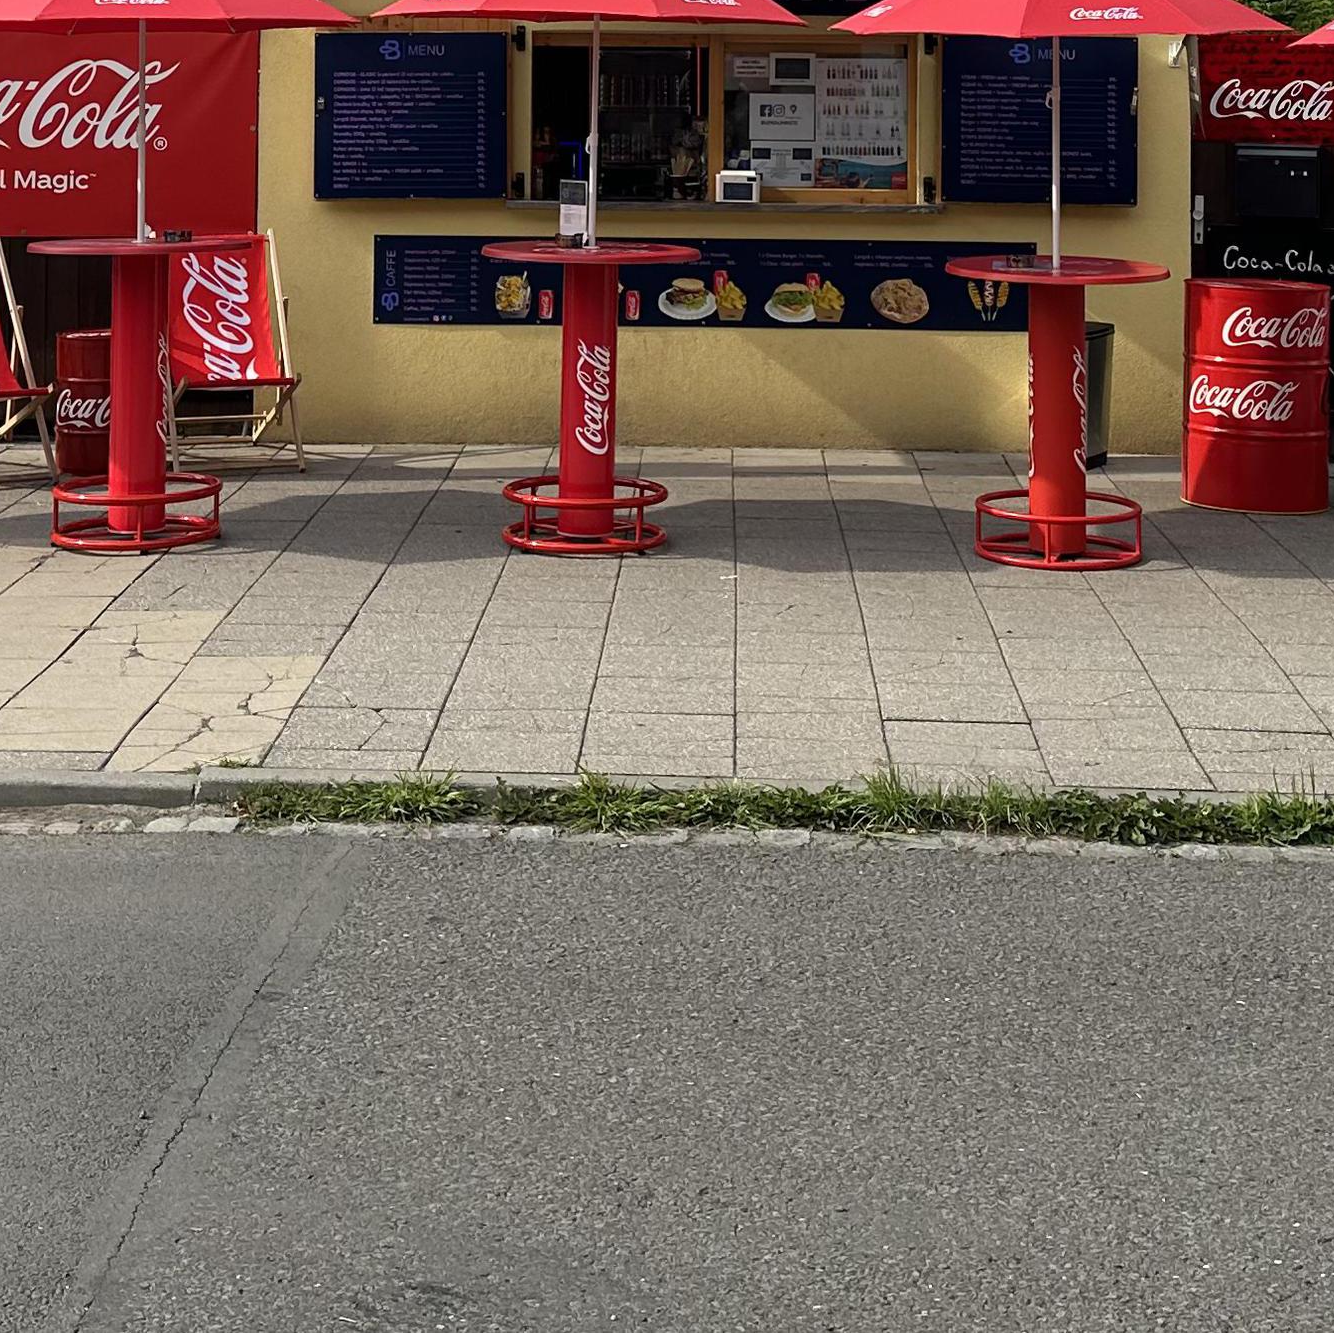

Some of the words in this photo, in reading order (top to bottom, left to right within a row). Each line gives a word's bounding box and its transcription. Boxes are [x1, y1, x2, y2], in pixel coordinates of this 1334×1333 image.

[1068, 6, 1145, 21] Coca-Cola
[407, 44, 446, 57] MENU
[13, 169, 89, 194] Magic
[385, 249, 397, 288] CAFFE
[1222, 245, 1324, 274] Coca-Cola
[1221, 306, 1328, 349] Coca-Cola
[574, 338, 611, 456] Coca-Cola
[1189, 374, 1302, 422] Coca-Cola
